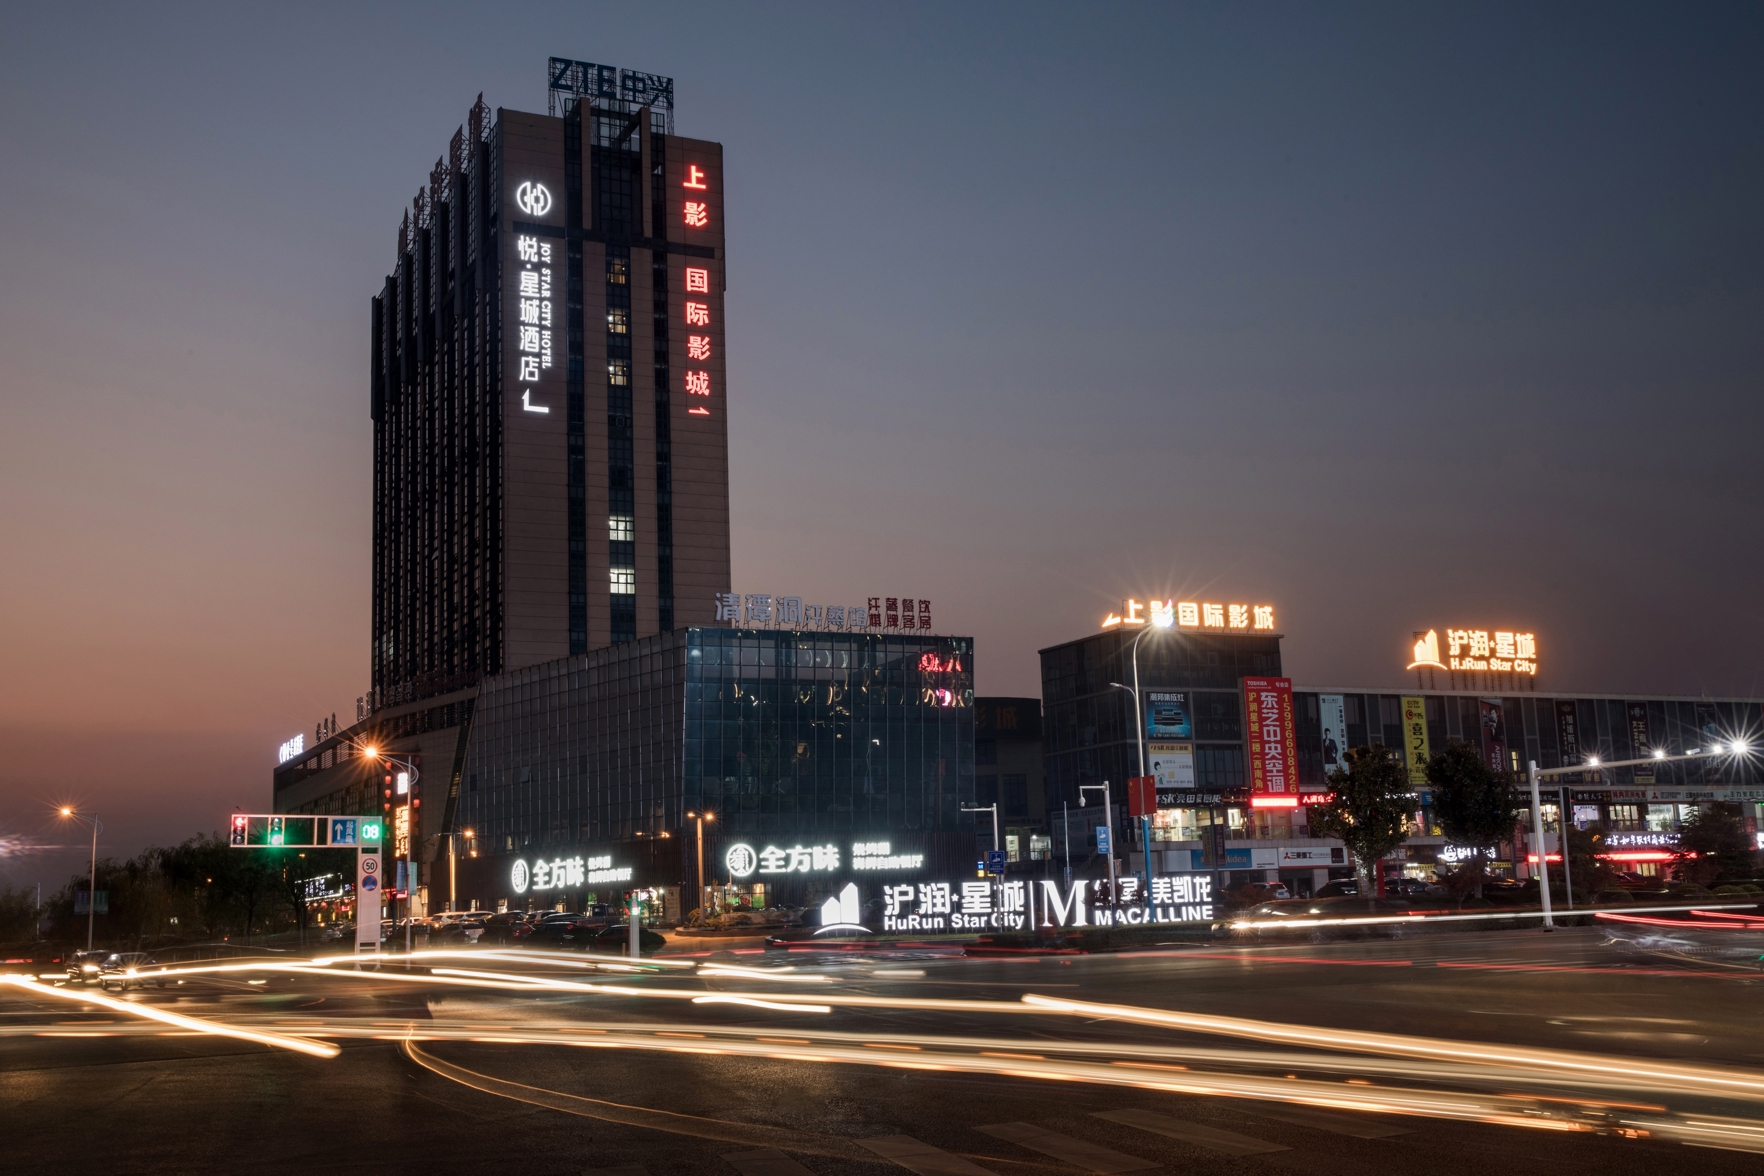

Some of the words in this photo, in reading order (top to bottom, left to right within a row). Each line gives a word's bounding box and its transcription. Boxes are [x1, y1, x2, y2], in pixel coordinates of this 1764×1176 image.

[551, 57, 616, 98] ZTE
[621, 70, 673, 109] 中兴
[540, 243, 551, 264] JOY
[541, 268, 551, 297] STAR
[541, 301, 551, 327] CITY
[541, 330, 552, 369] HOTEL
[1123, 599, 1274, 630] 上影国际影城
[1489, 658, 1512, 671] Star
[1514, 659, 1537, 675] City
[1260, 691, 1285, 793] 东芝中央空调
[1282, 693, 1297, 794] 15996608426
[362, 824, 379, 839] 08
[365, 862, 375, 870] 50
[533, 856, 584, 889] 全方味
[759, 844, 839, 872] 全方味
[883, 915, 944, 931] HuRun
[951, 913, 988, 929] Star
[991, 912, 1025, 930] City
